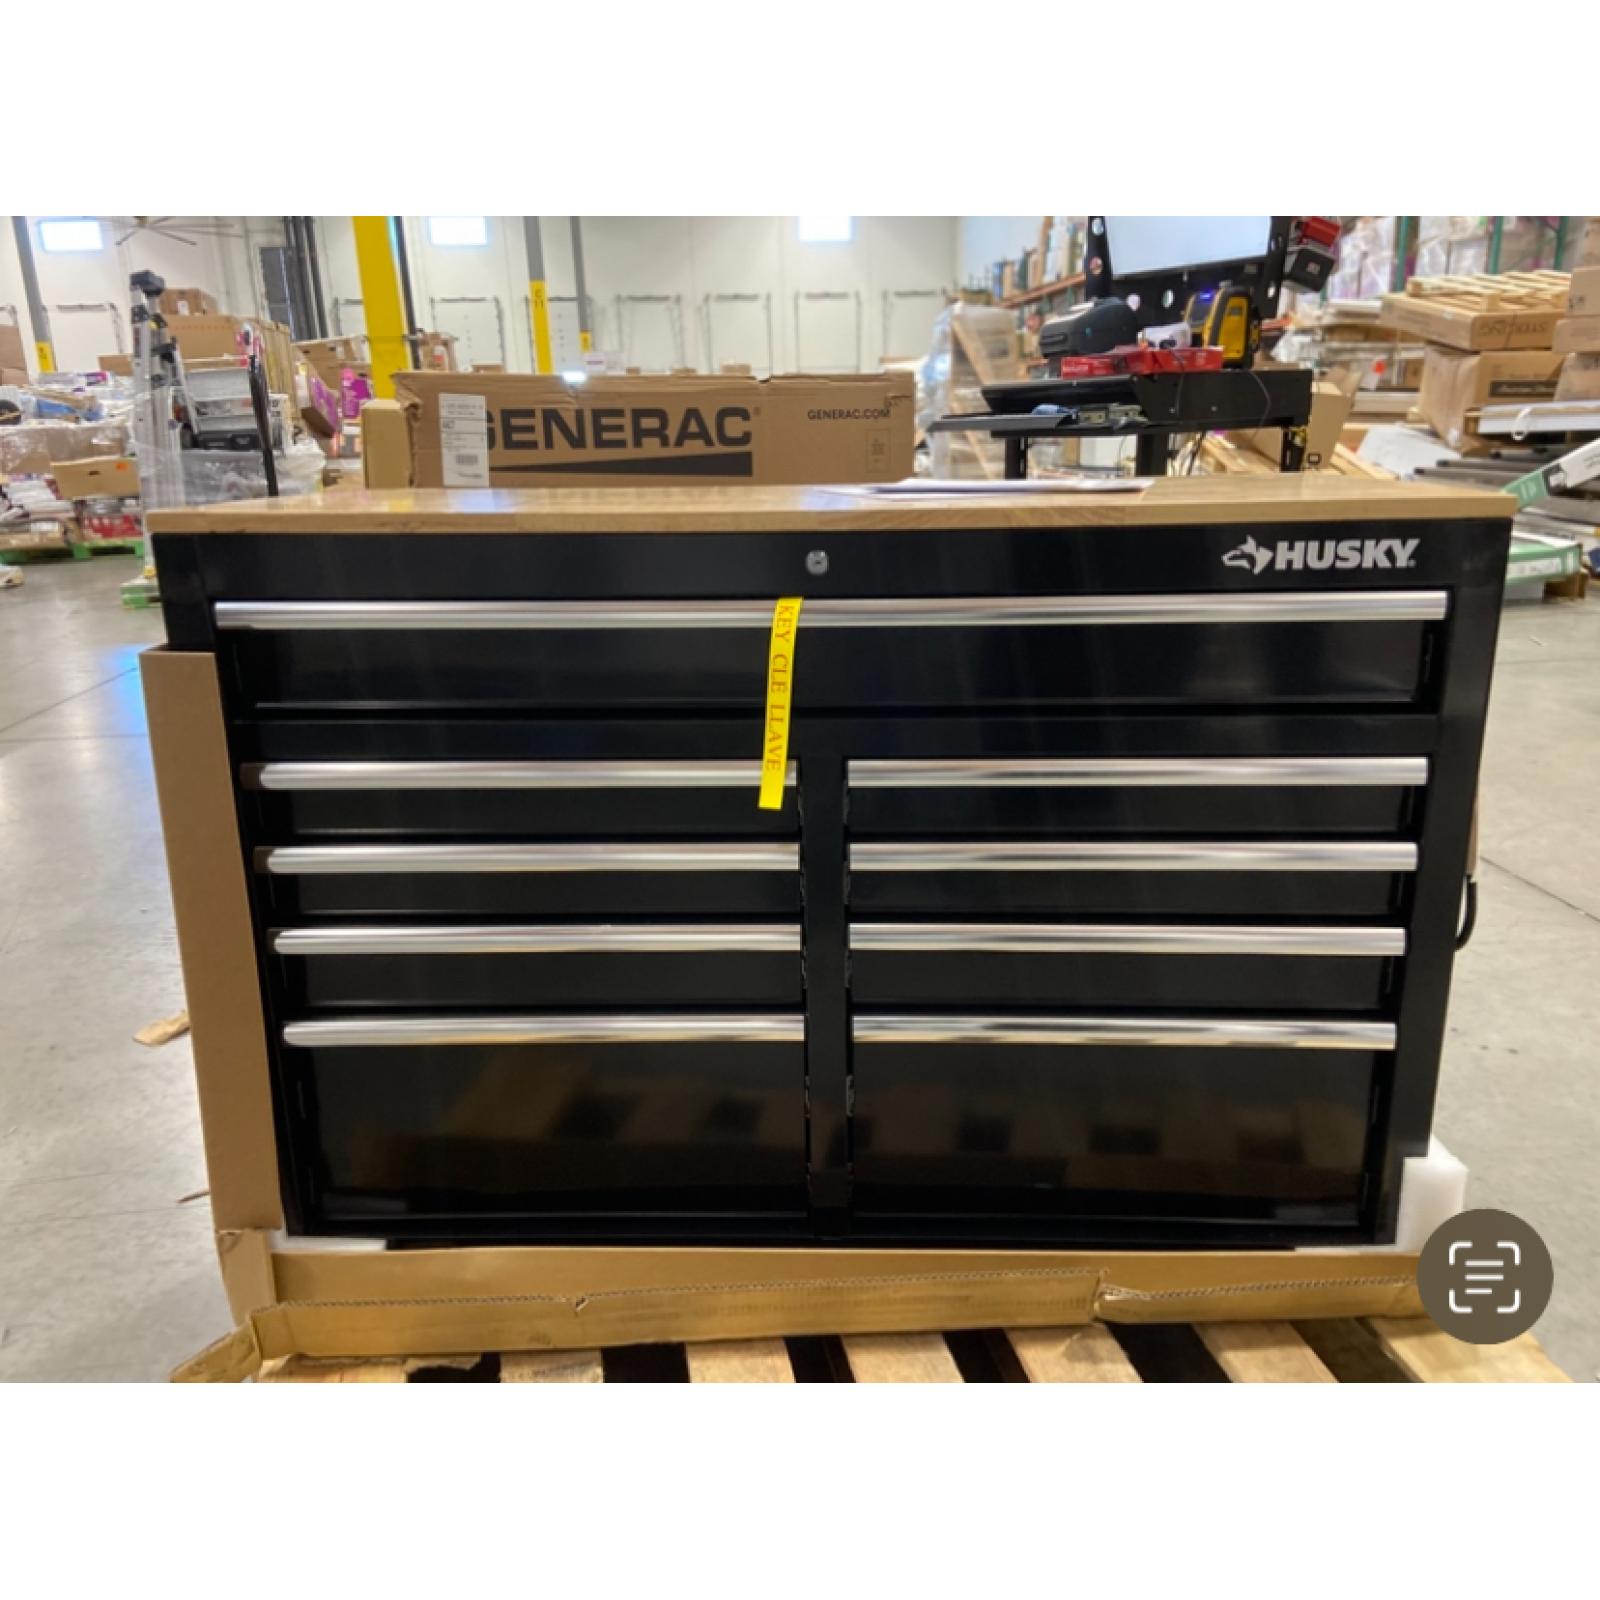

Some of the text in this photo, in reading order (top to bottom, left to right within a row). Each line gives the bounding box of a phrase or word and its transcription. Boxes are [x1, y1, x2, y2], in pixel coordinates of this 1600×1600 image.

[487, 407, 752, 449] ENERAC
[807, 408, 890, 420] GENERAC.COM
[1274, 538, 1420, 570] HUSKY
[774, 605, 795, 642] KEY
[766, 704, 785, 771] LLAVE
